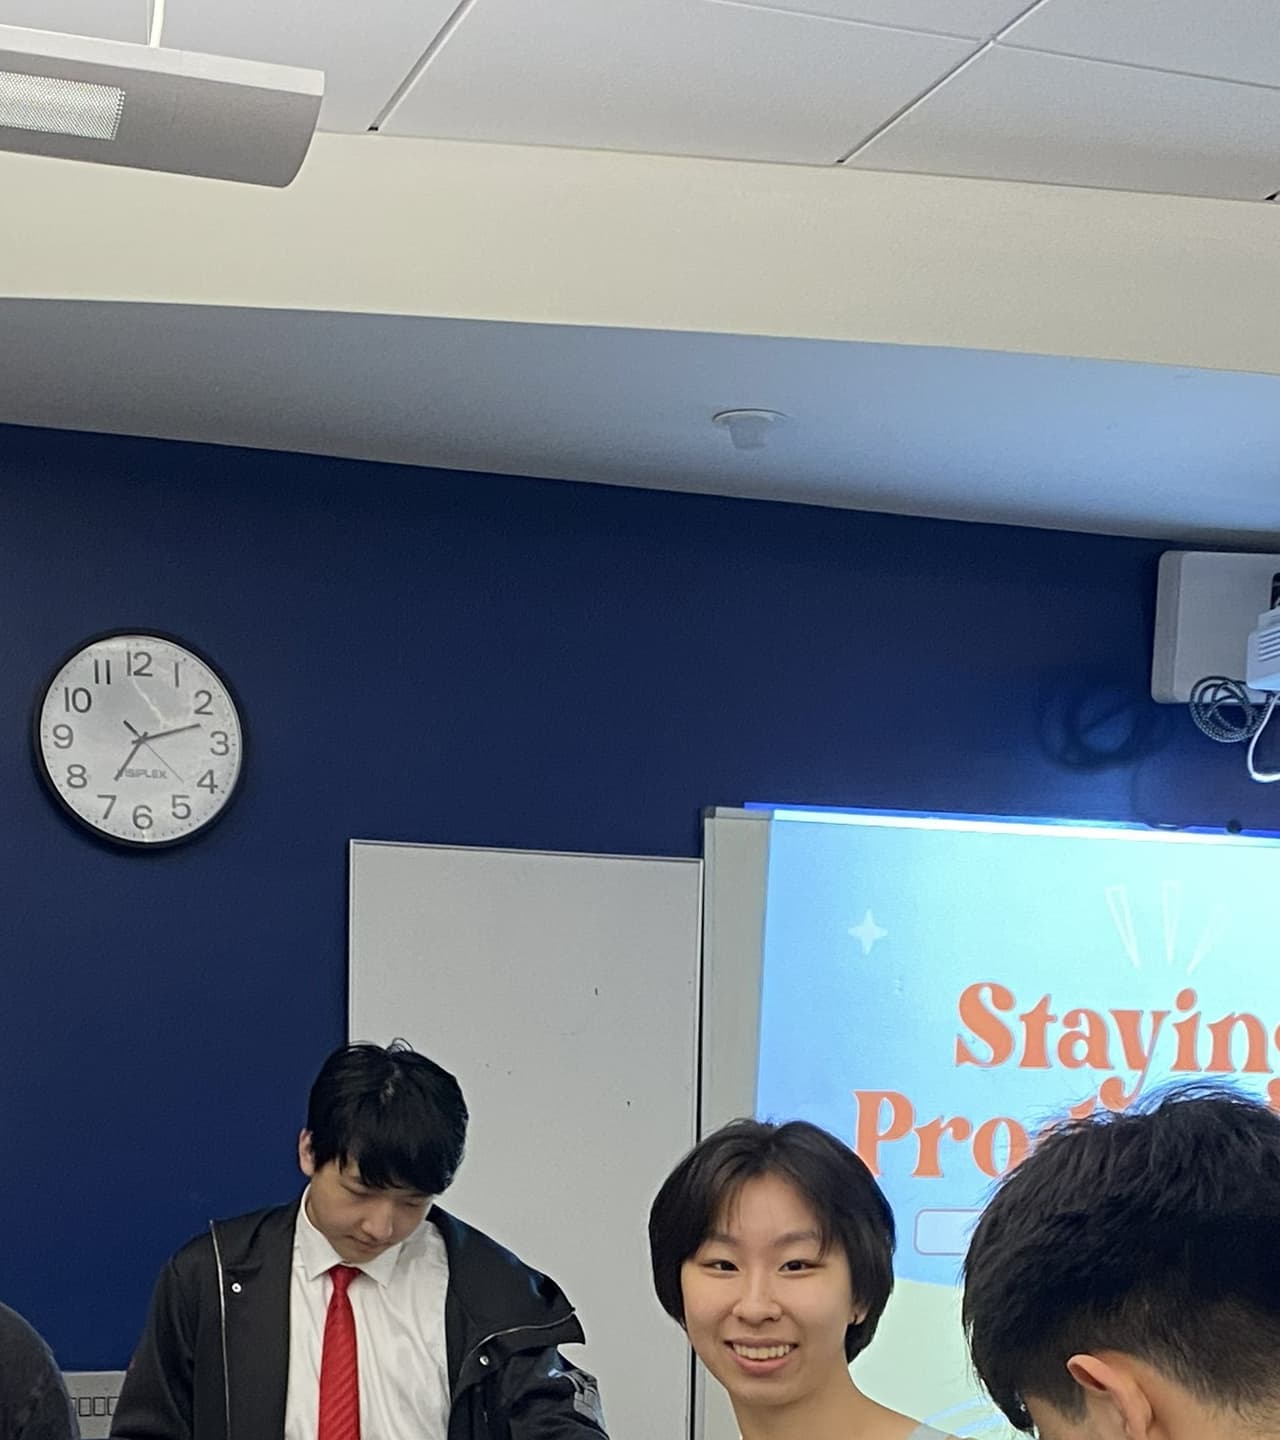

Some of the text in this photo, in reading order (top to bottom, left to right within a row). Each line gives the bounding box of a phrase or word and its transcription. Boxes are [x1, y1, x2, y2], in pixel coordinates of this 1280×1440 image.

[94, 659, 111, 685] 11
[126, 651, 153, 677] 12
[64, 686, 92, 713] 10
[193, 690, 214, 715] 2
[52, 724, 74, 749] 9
[210, 731, 230, 756] 3
[66, 764, 88, 789] 8
[196, 769, 219, 794] 4
[97, 794, 117, 820] 7
[132, 804, 153, 830] 6
[171, 794, 192, 820] 5
